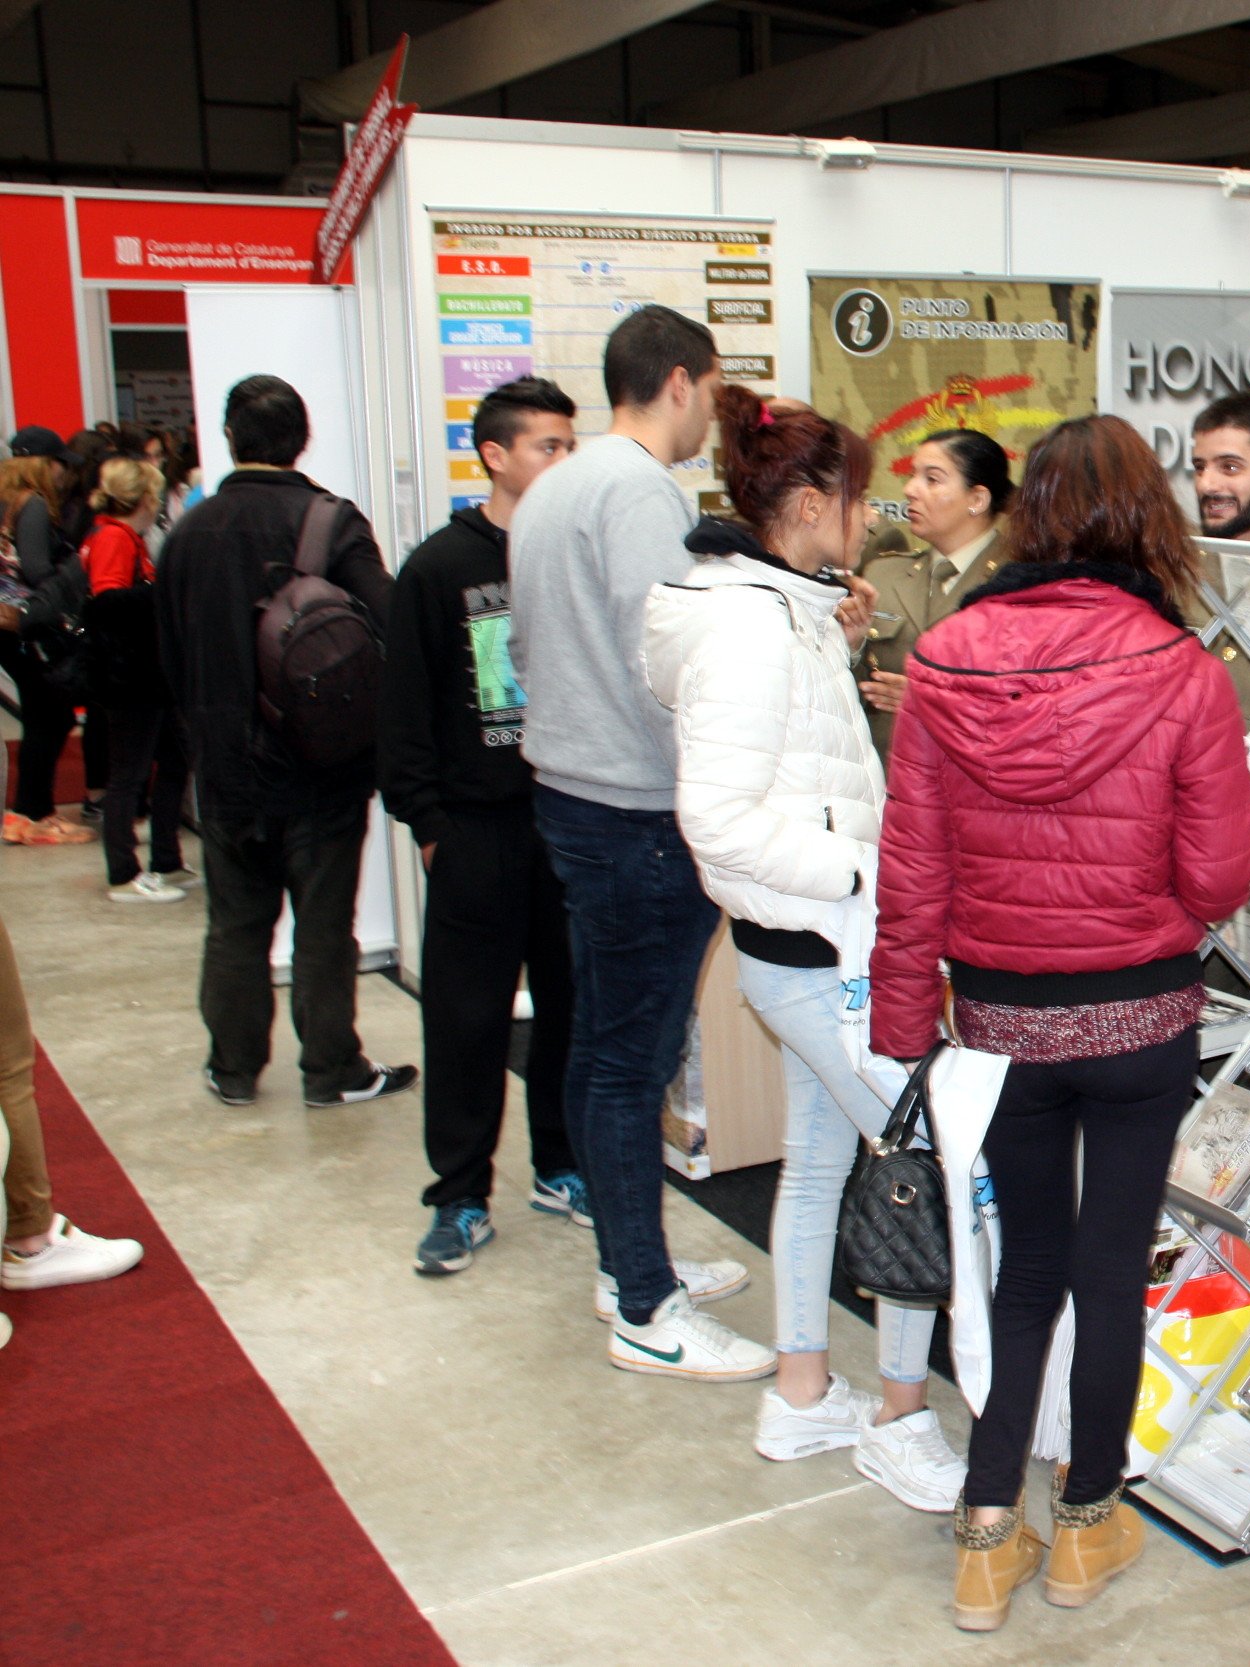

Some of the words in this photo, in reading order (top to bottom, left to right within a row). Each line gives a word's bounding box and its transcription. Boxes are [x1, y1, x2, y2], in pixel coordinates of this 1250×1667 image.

[447, 223, 504, 236] INGRESO
[506, 225, 533, 237] POR
[535, 226, 583, 239] ACCESO
[586, 227, 639, 240] DIRECTO
[717, 231, 760, 244] TIERRA
[148, 253, 237, 269] Departament
[901, 297, 969, 317] PUNTO
[901, 321, 930, 339] DE
[933, 319, 1068, 341] INFORMACIÓN
[720, 357, 768, 372] UBOFICIAL
